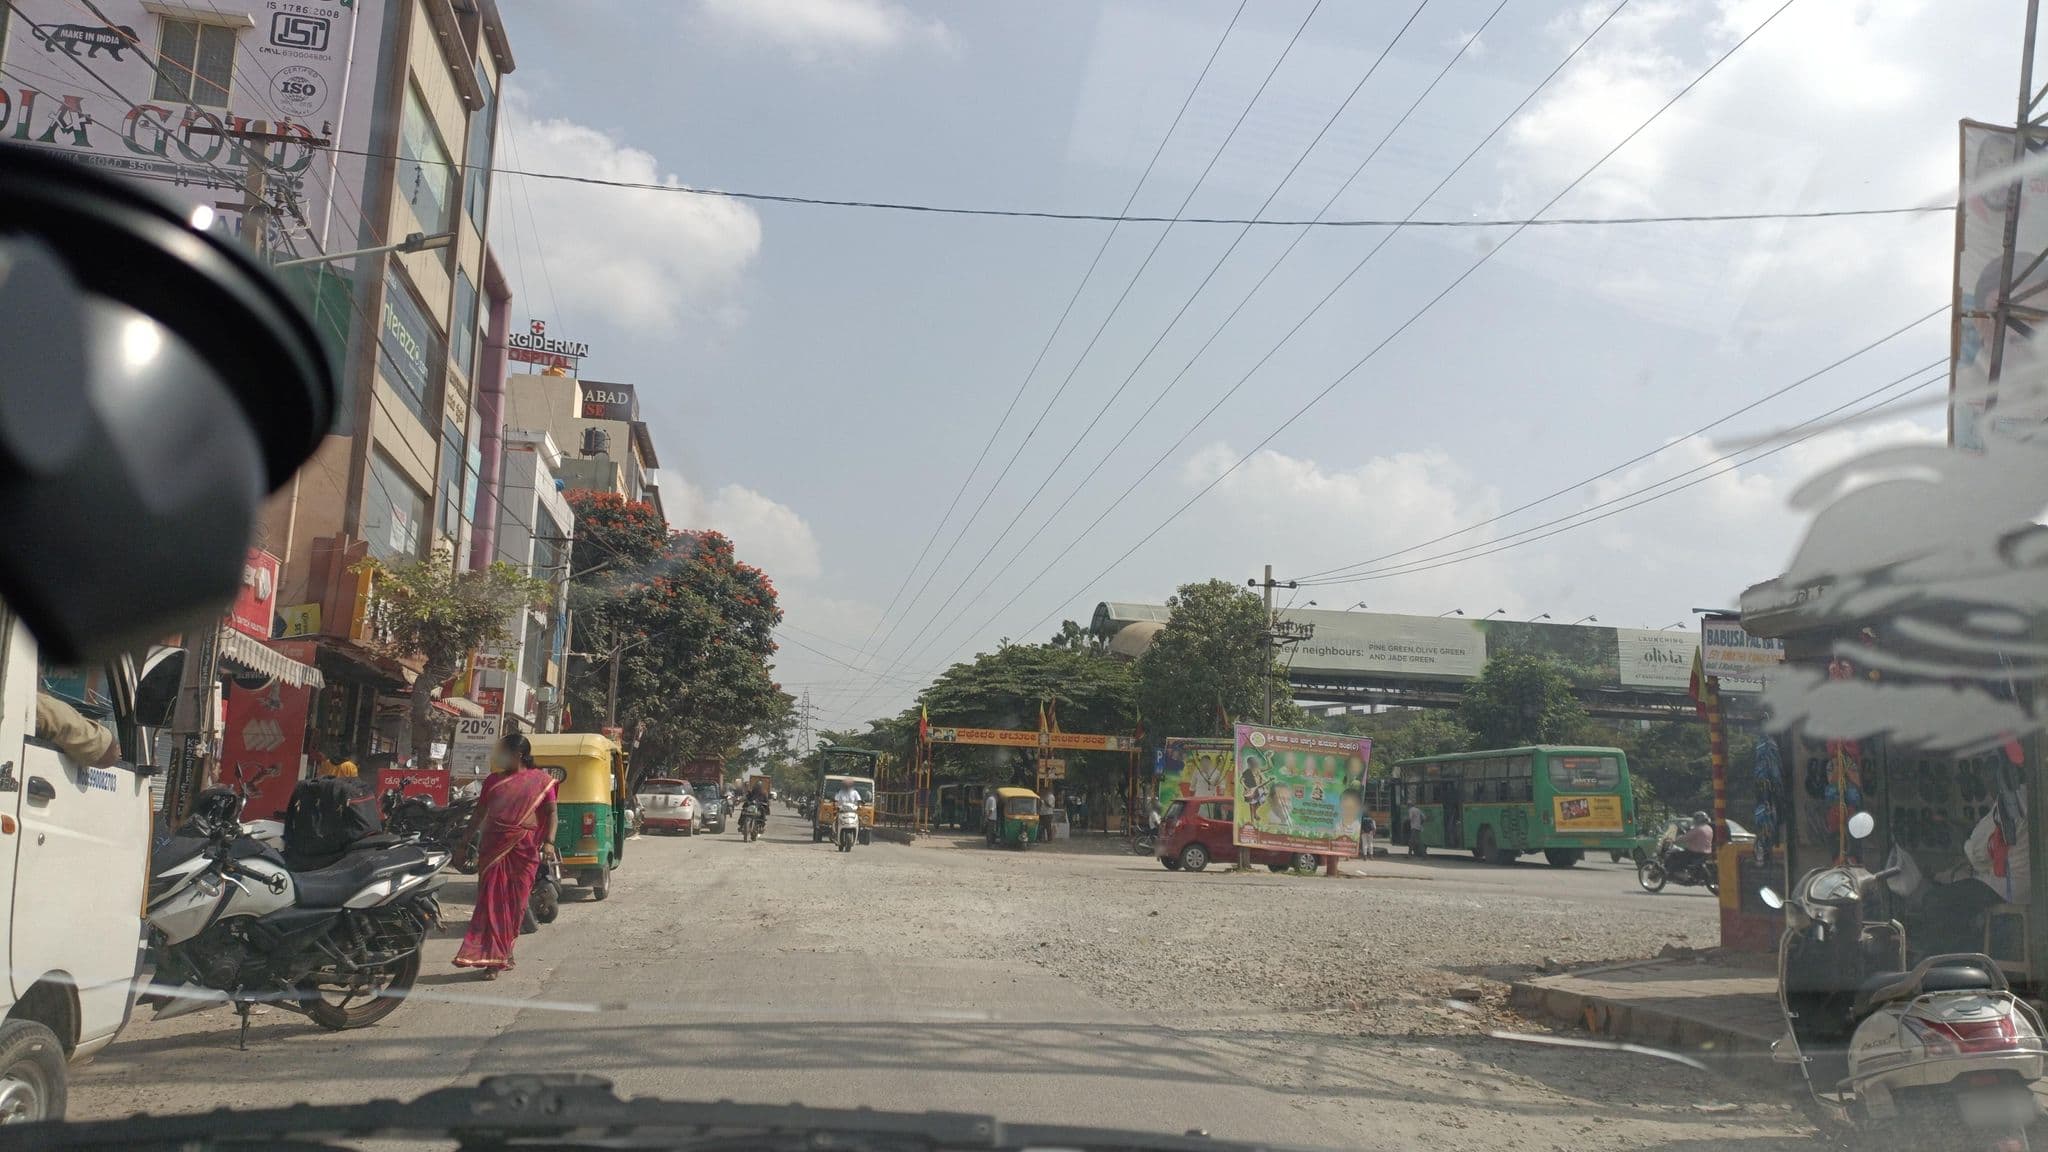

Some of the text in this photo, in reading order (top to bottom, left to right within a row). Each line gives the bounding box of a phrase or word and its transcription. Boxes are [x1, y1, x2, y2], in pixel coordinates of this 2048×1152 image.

[266, 1, 277, 10] IS
[60, 28, 120, 45] MAKE IN INDIA
[281, 81, 316, 97] ISO
[121, 104, 317, 173] GOLD
[508, 332, 589, 356] RGIDERMA
[584, 390, 629, 405] ABAD
[1638, 635, 1684, 644] LAUNCHING
[1302, 644, 1364, 657] neighbours:
[1368, 643, 1386, 652] PINE
[1440, 647, 1466, 656] GREEN
[1644, 646, 1683, 664] olivia
[1387, 654, 1408, 662] JADE
[460, 719, 495, 735] 20%
